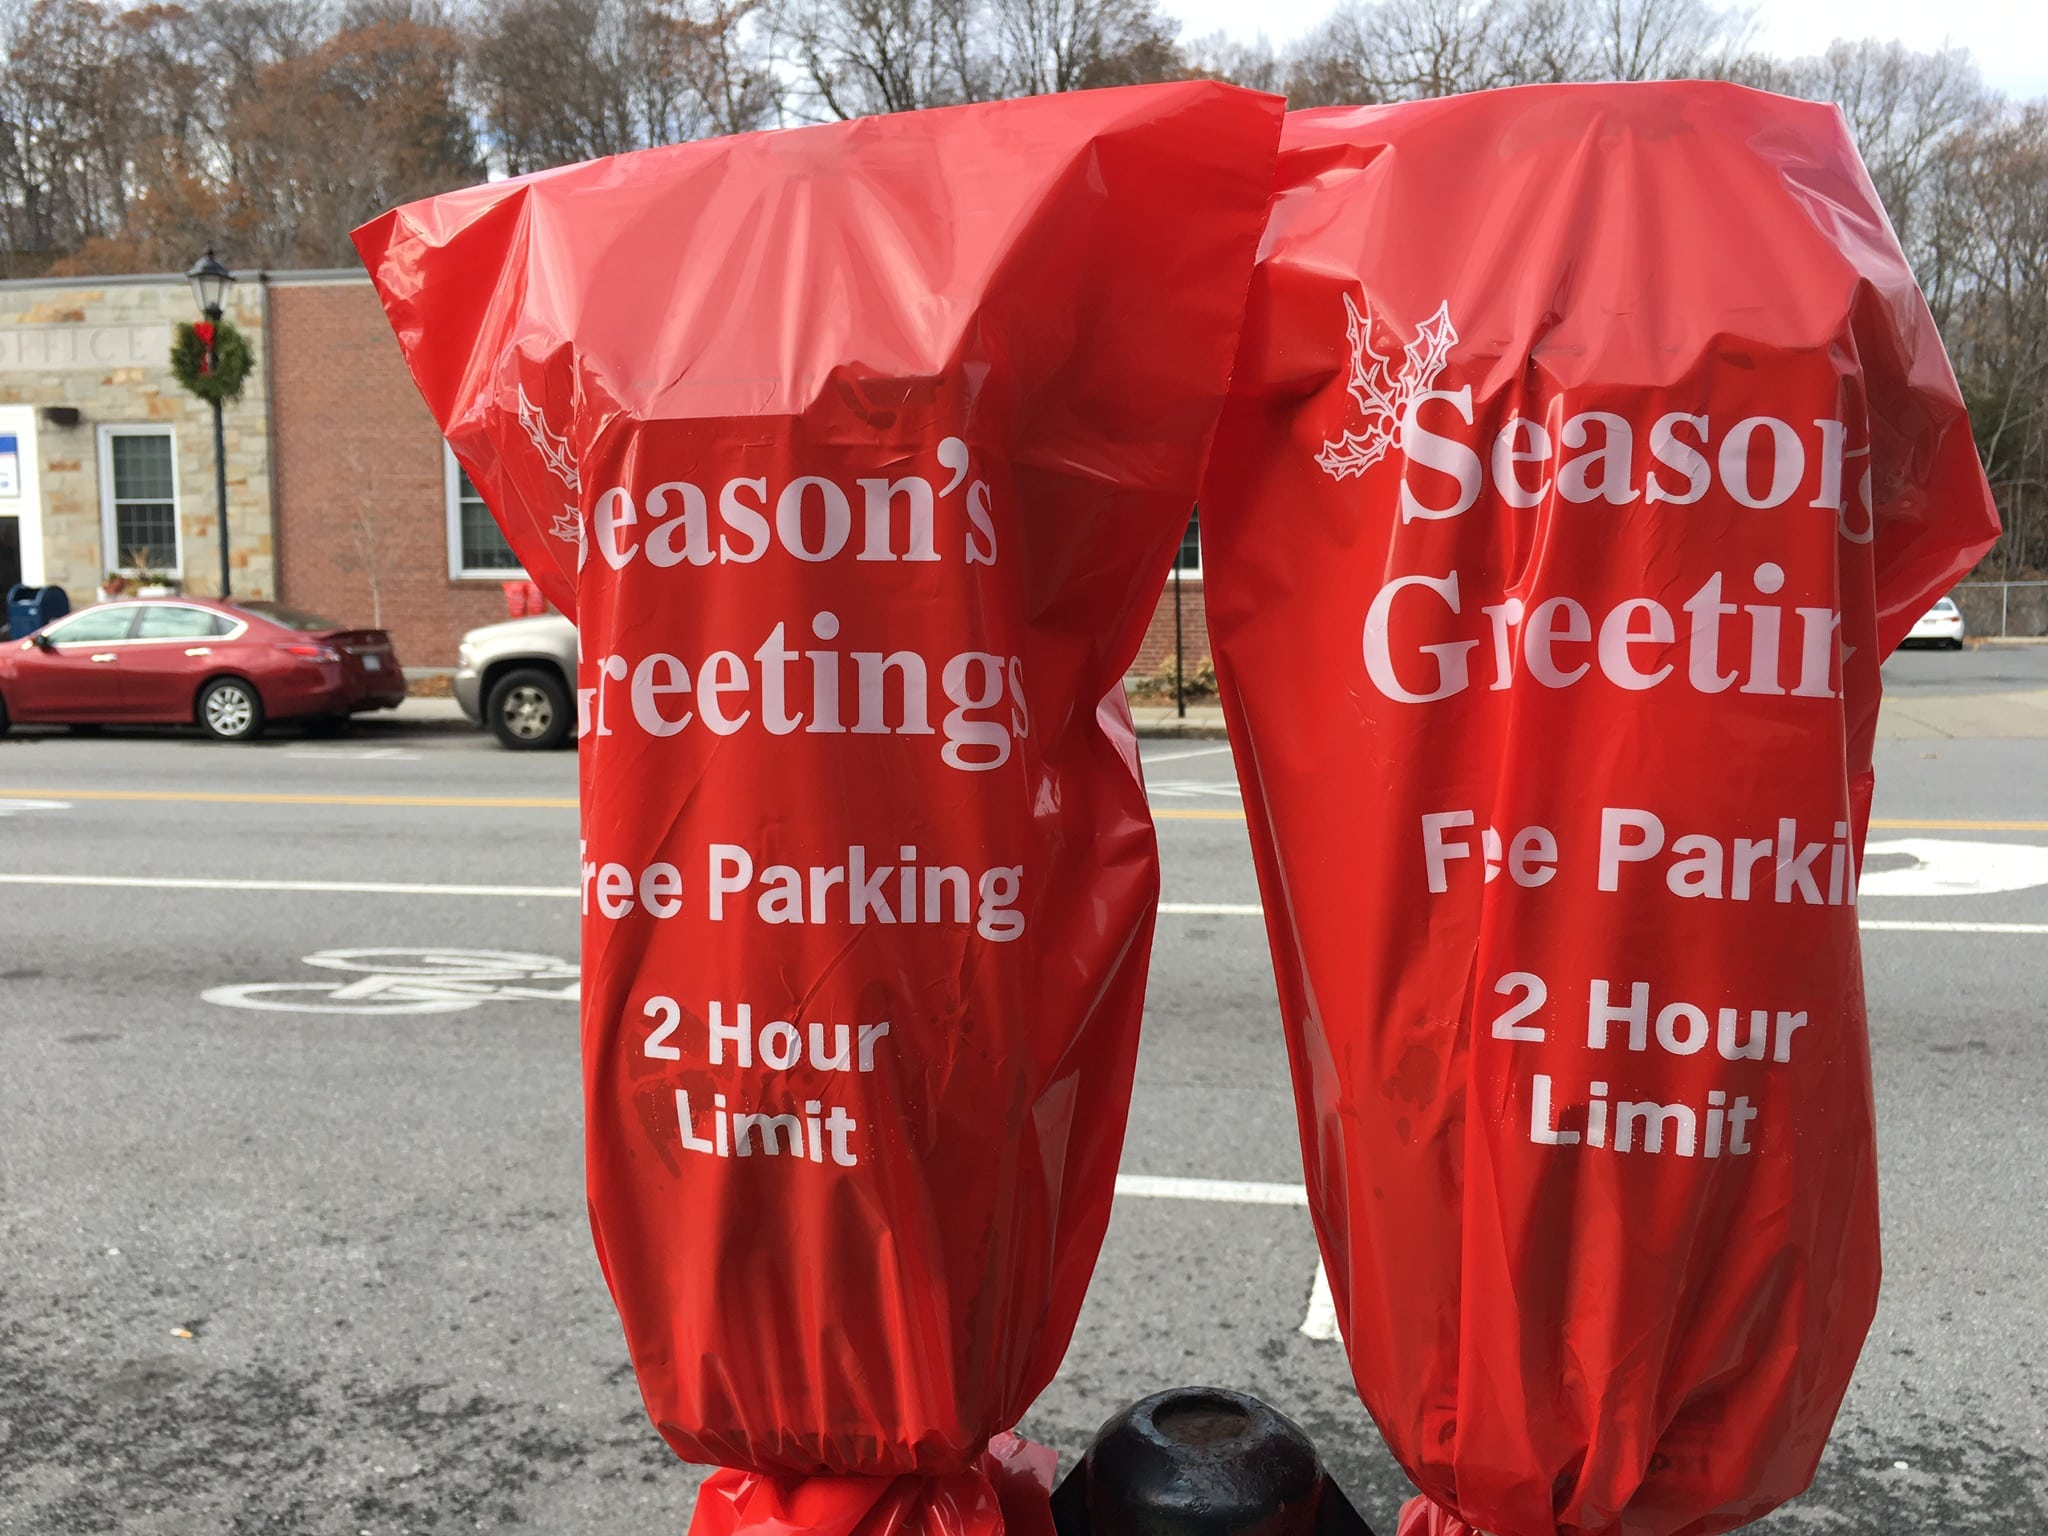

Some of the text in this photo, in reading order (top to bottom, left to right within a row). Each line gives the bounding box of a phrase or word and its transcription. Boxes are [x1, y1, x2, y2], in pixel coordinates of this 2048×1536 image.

[0, 327, 148, 363] FFICE
[578, 437, 998, 574] eason's
[580, 839, 1026, 942] ree Parking
[1598, 807, 1857, 906] Parki
[643, 996, 890, 1073] 2 Hour
[1491, 971, 1808, 1063] 2 Hour
[675, 1088, 858, 1167] Limit
[1530, 1073, 1757, 1159] Limit
